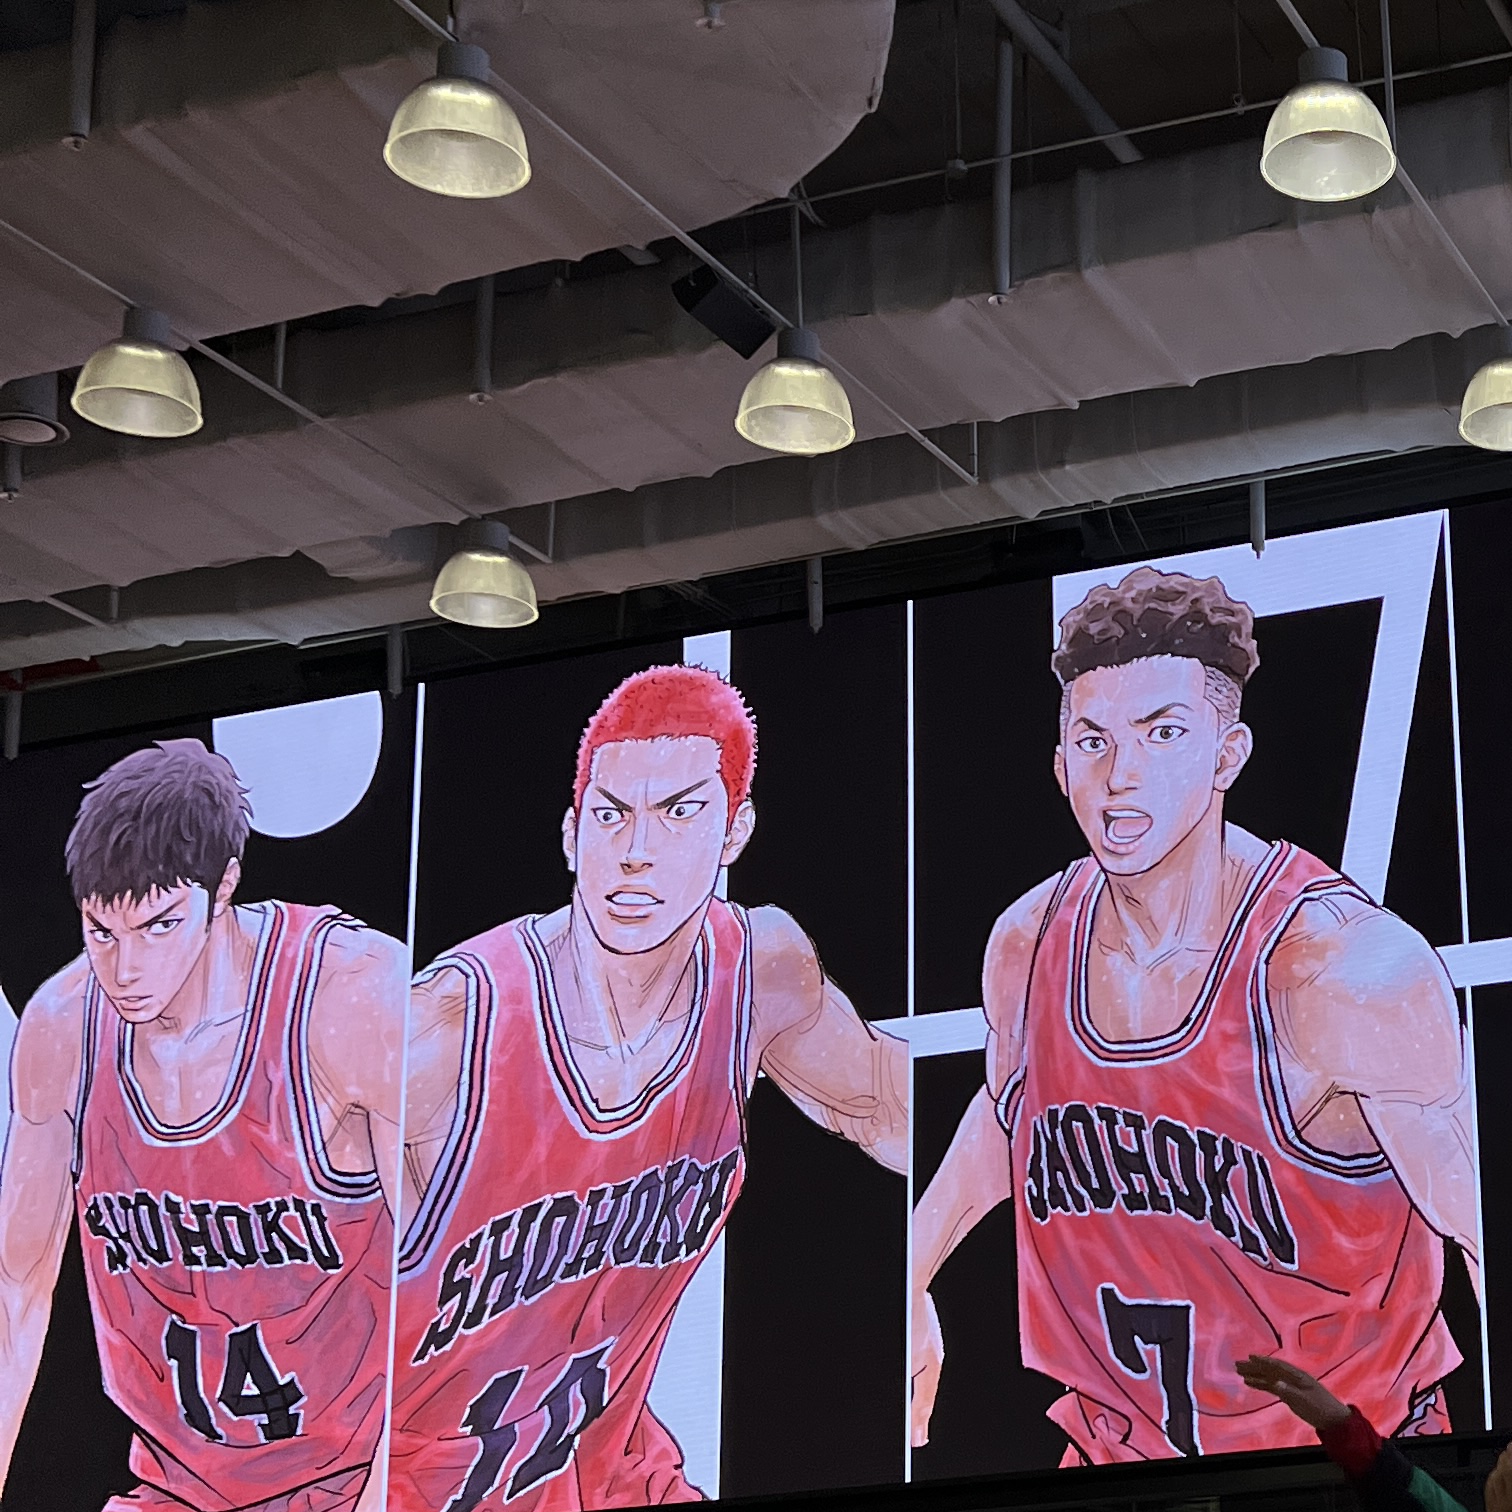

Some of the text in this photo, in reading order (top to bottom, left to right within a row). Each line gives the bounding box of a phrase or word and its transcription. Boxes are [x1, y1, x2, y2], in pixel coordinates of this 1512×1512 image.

[411, 1148, 742, 1367] SHOHOKU
[161, 1314, 306, 1446] 14
[1098, 1283, 1205, 1457] 7
